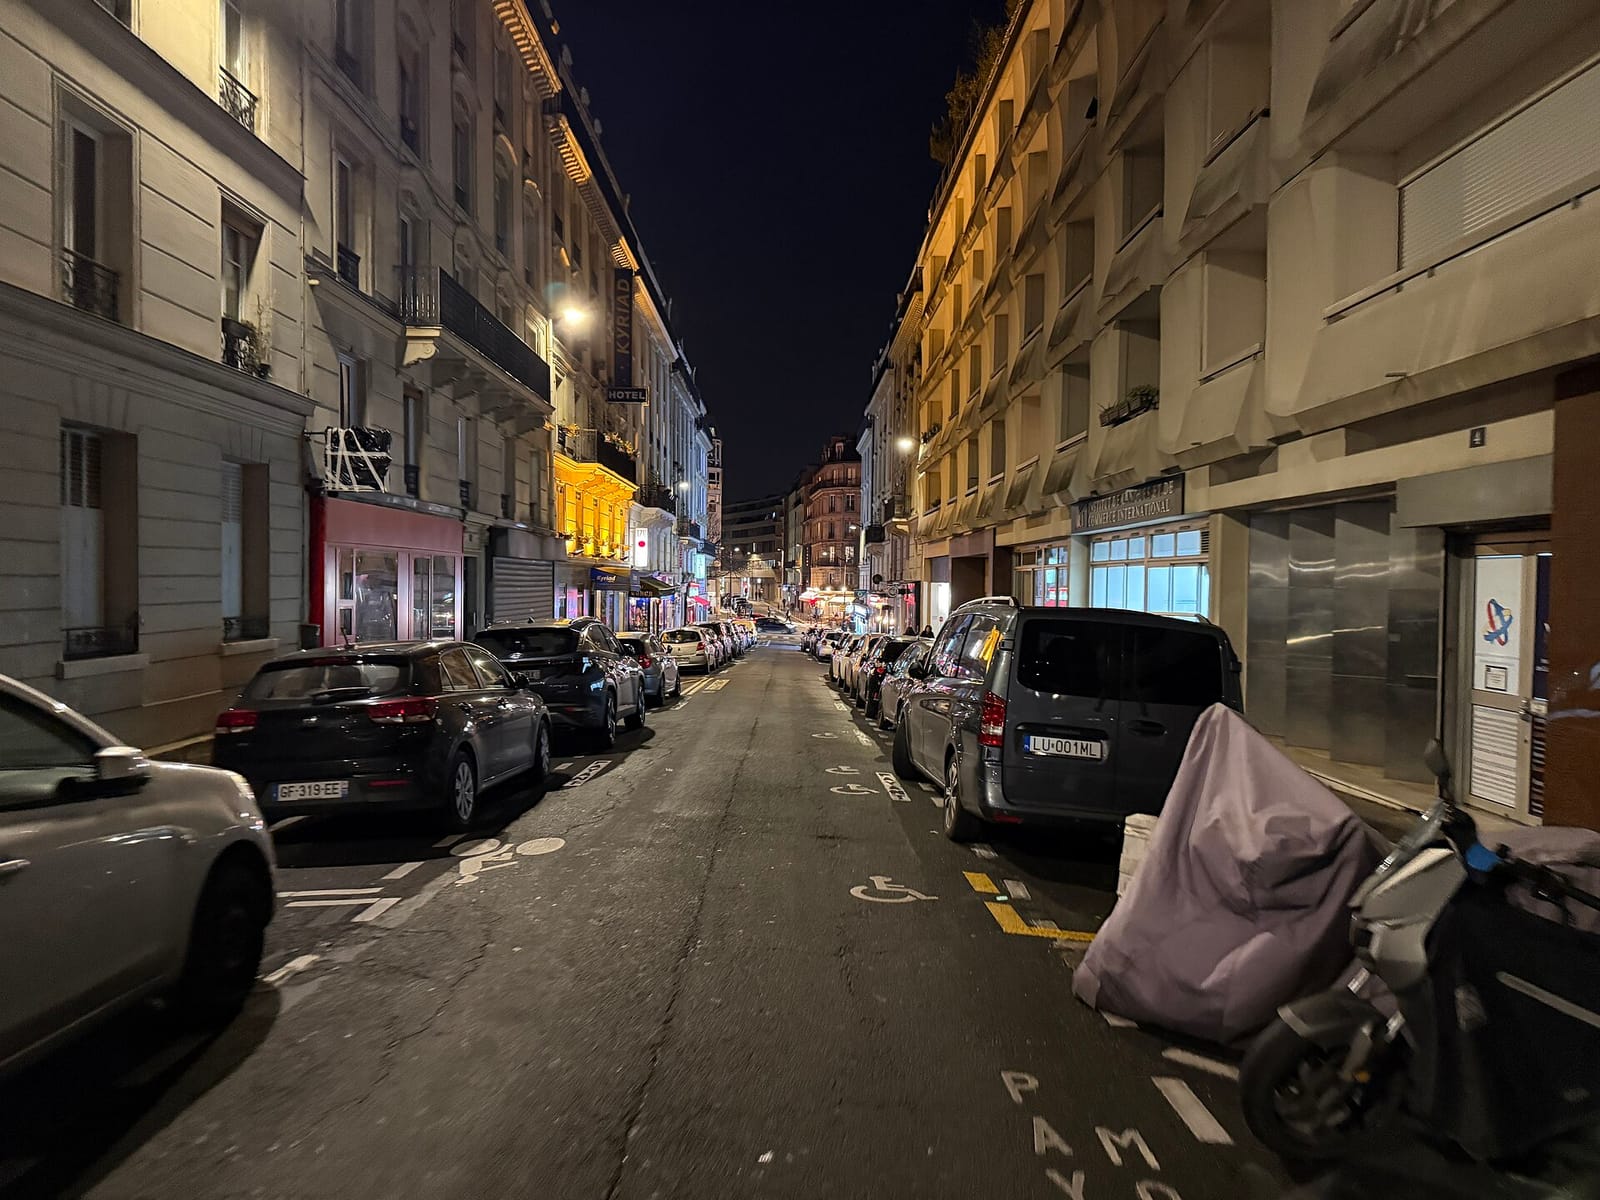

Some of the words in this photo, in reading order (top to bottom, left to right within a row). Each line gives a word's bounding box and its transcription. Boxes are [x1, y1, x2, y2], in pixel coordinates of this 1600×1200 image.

[616, 279, 630, 354] KYRIAD
[608, 390, 646, 400] HOTEL
[1117, 498, 1170, 521] INTERNATIONAL
[280, 782, 340, 798] GF-319-EE
